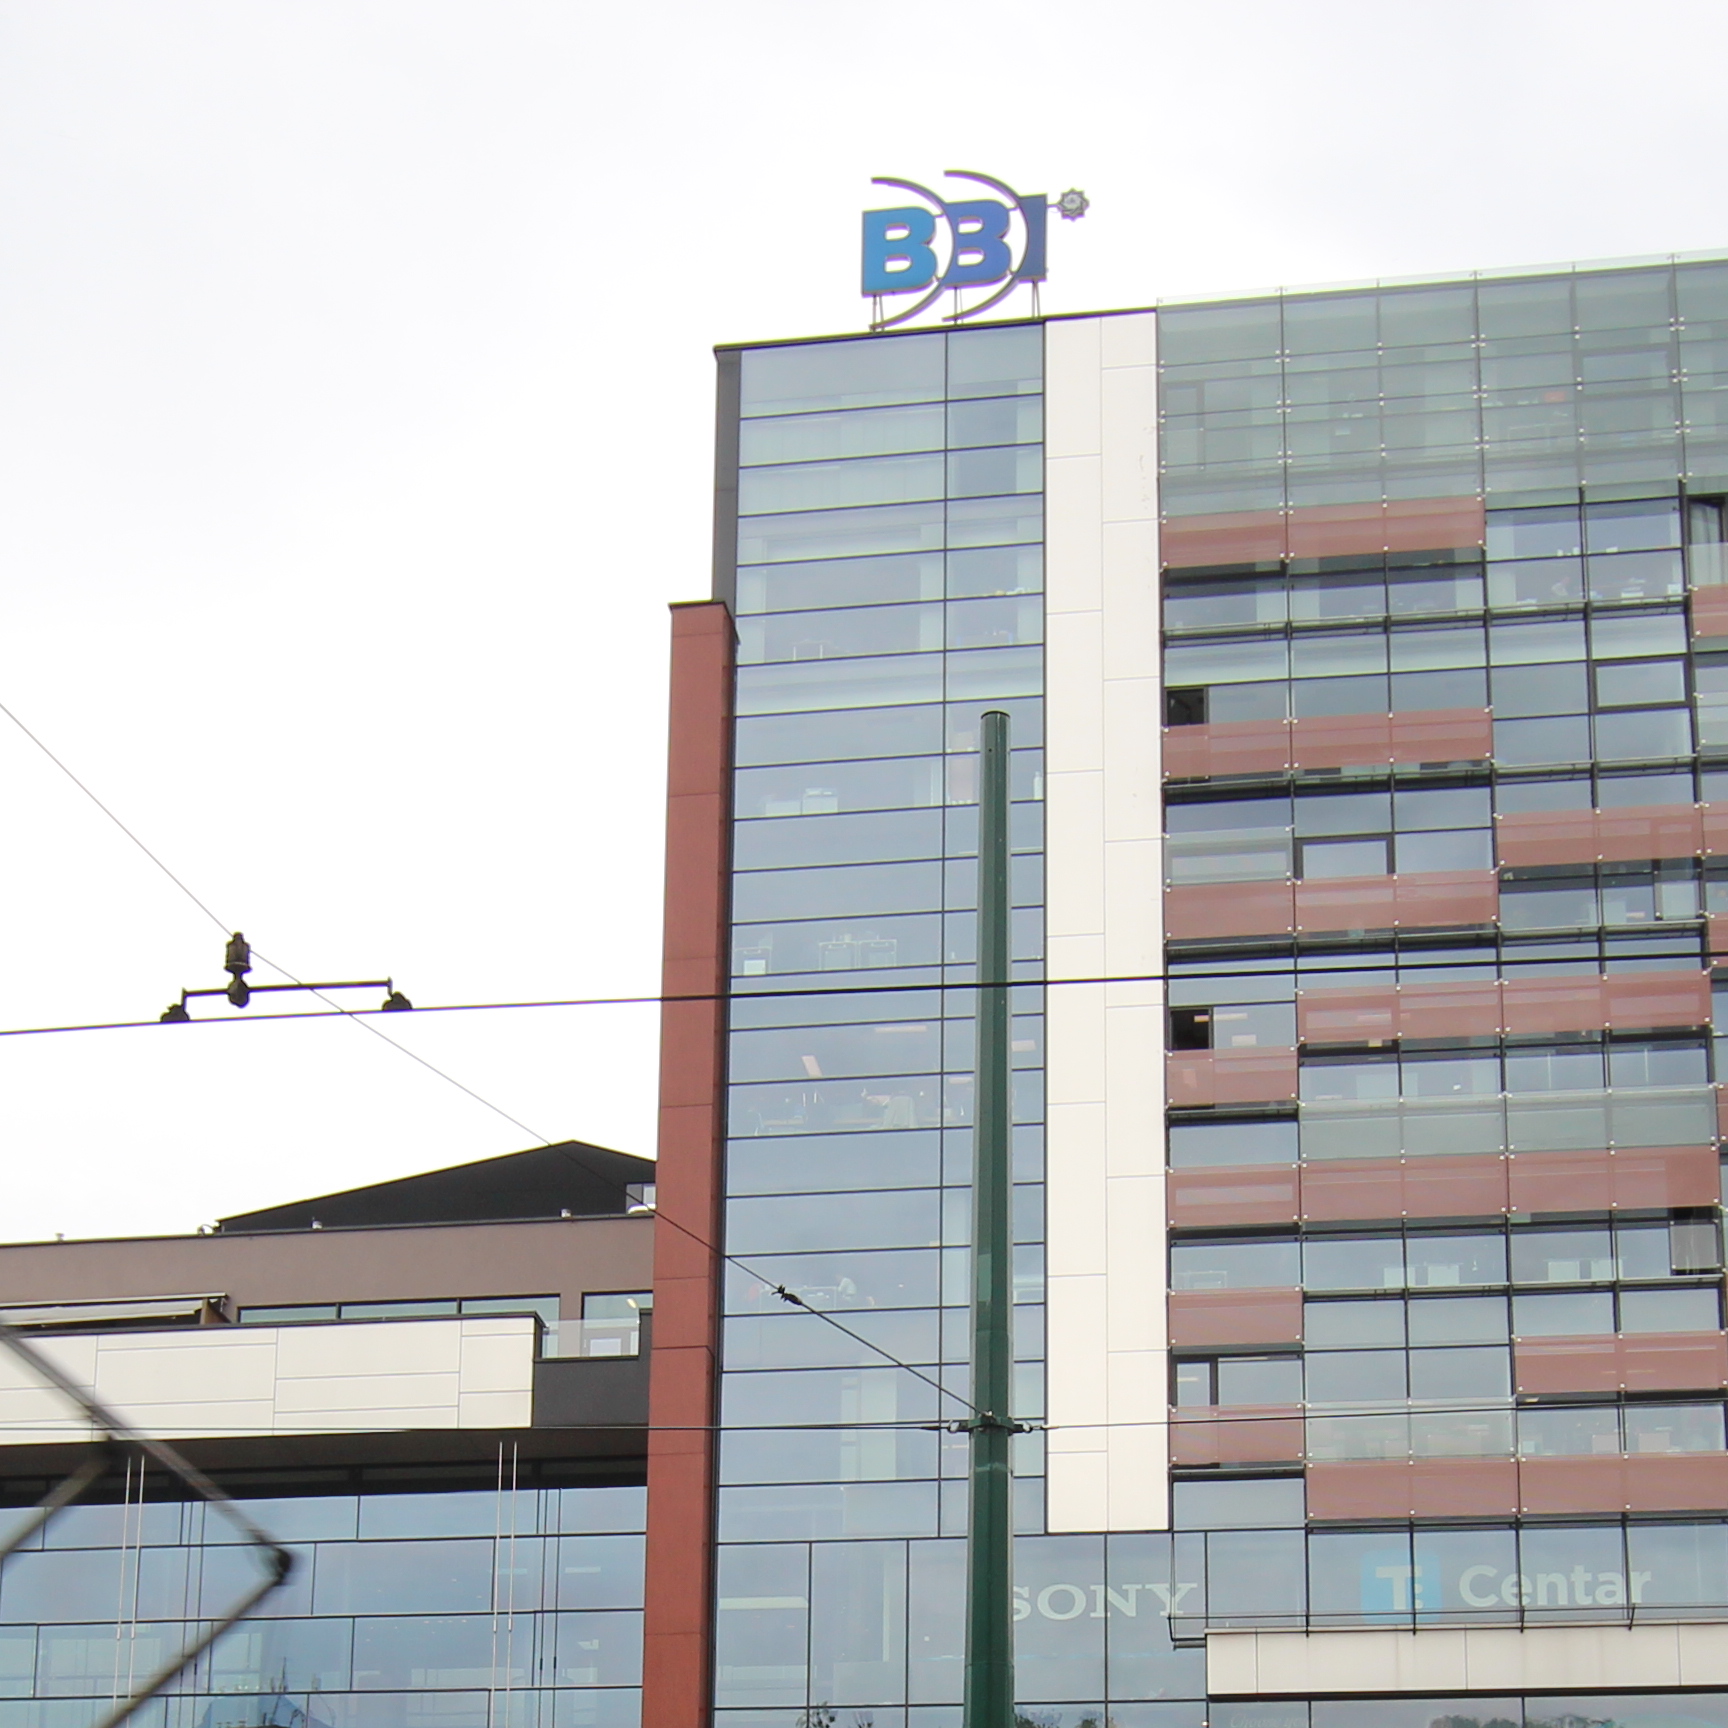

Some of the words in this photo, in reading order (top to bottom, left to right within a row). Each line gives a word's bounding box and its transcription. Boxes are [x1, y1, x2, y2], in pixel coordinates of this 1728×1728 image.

[860, 190, 1048, 299] BBI
[1012, 1582, 1199, 1622] SONY
[1458, 1563, 1652, 1608] Centar
